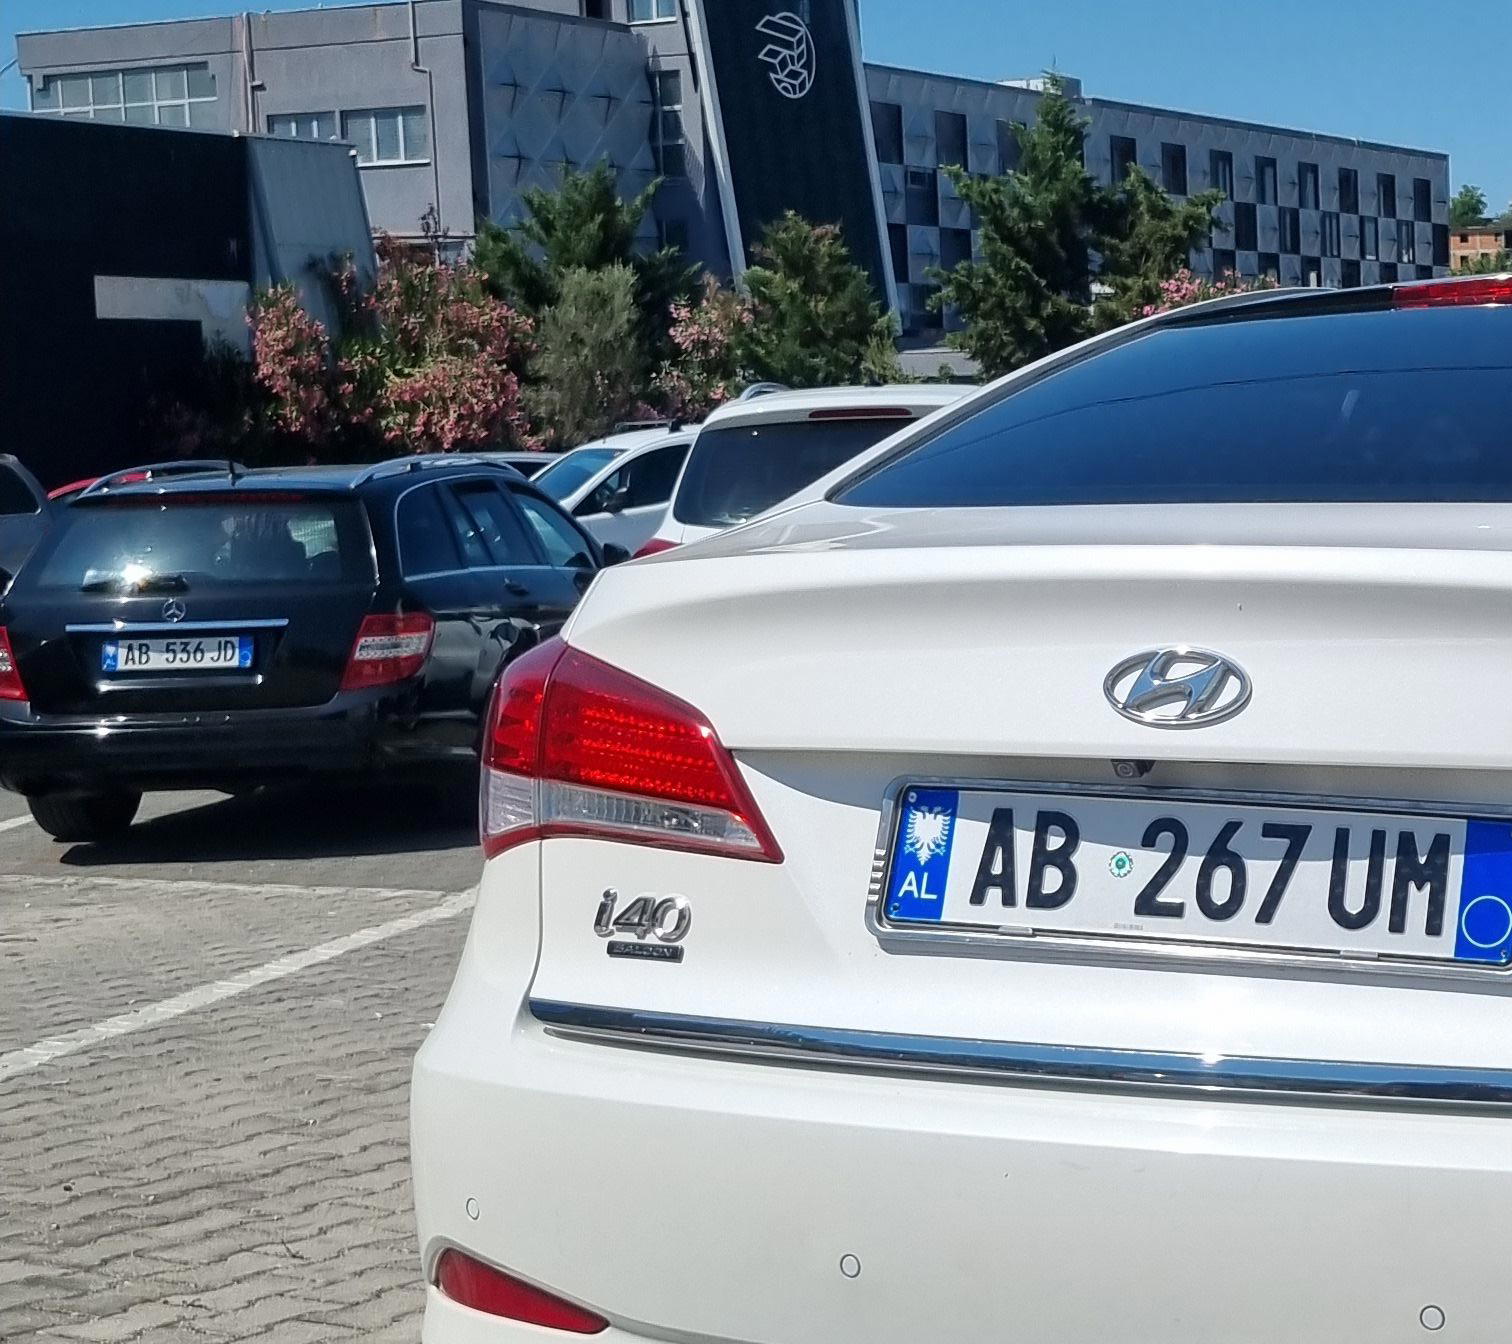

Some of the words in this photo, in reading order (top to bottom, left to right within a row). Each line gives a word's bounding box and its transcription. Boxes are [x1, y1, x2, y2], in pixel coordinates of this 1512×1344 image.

[124, 642, 150, 666] AB
[165, 641, 204, 664] 536
[210, 640, 236, 663] JD
[898, 871, 938, 899] AL
[969, 808, 1081, 909] AB
[1134, 817, 1314, 924] 267
[1327, 827, 1451, 937] UM
[594, 888, 691, 943] i40
